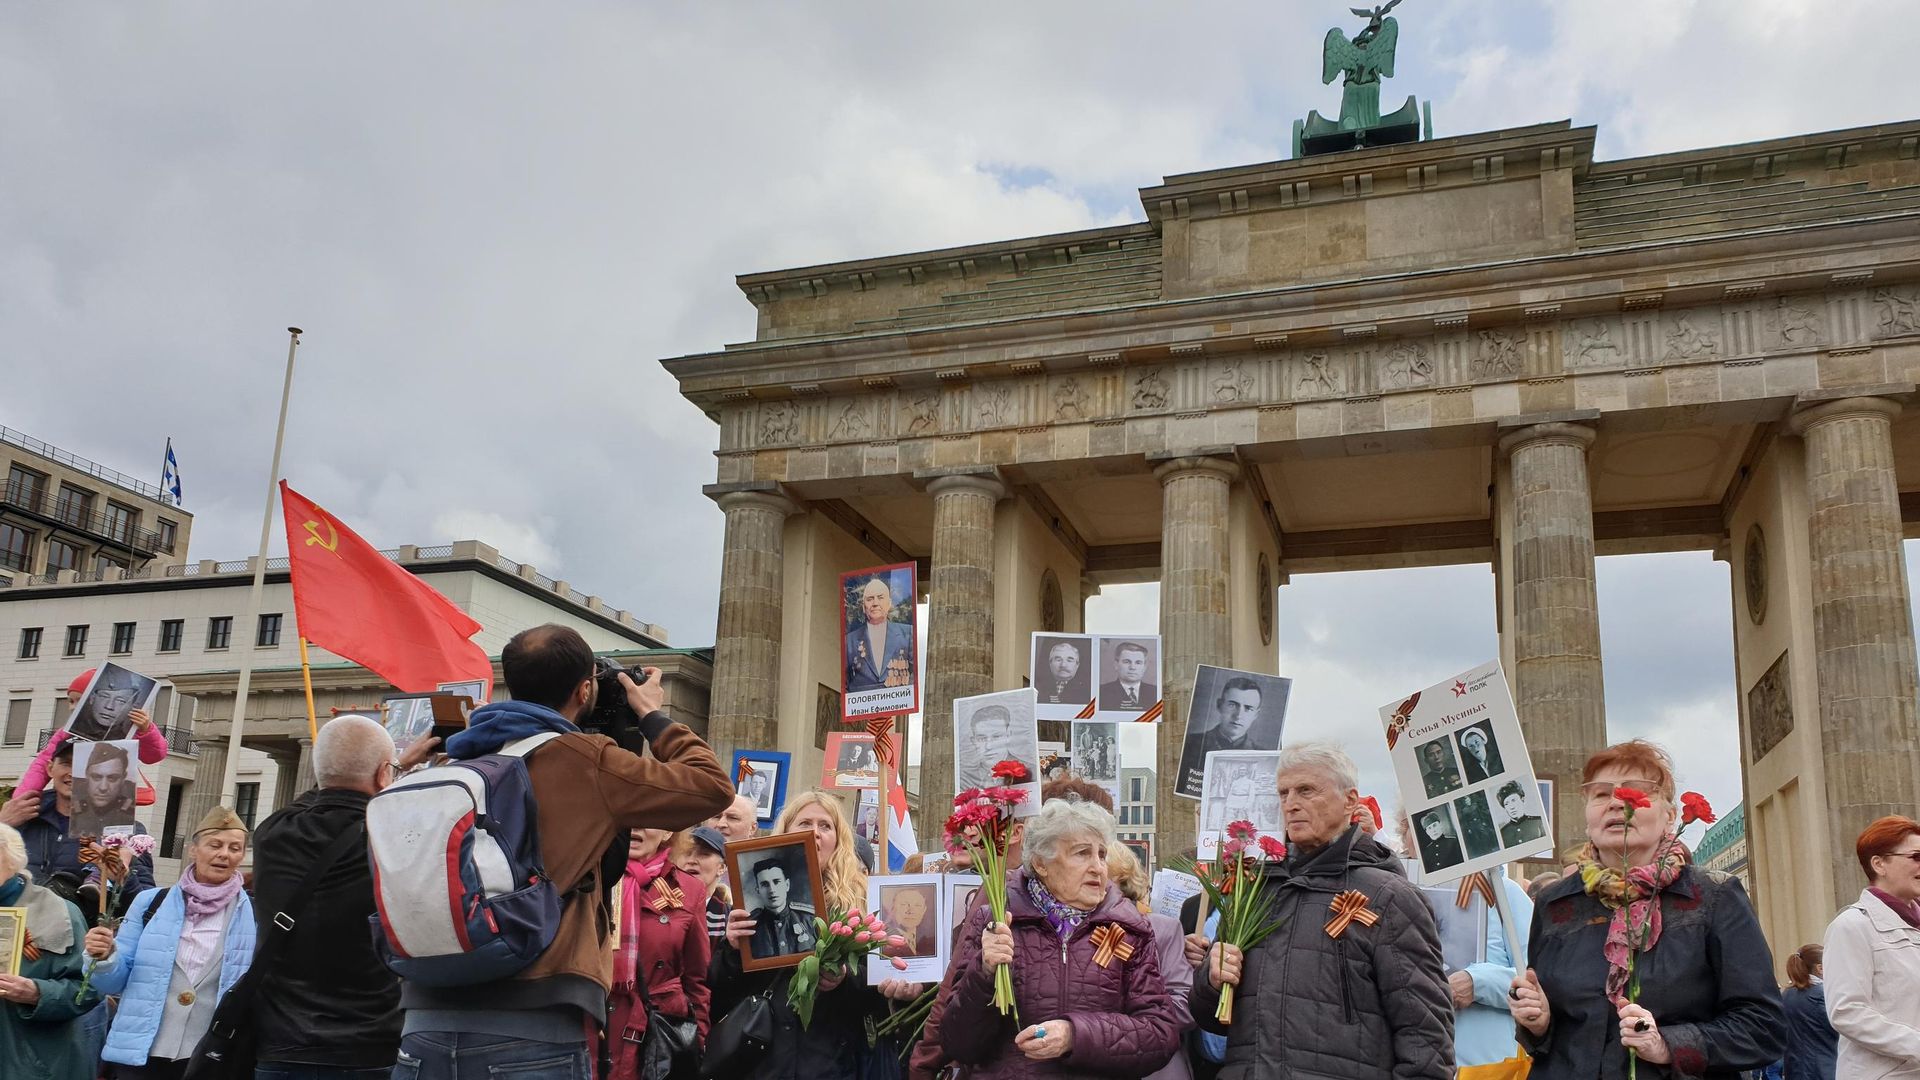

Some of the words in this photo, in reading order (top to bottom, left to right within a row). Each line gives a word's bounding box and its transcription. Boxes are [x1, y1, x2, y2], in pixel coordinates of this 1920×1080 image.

[847, 689, 911, 705] ГОЛОВЯТИНСКИЙ
[870, 703, 908, 714] Ефимович
[1408, 722, 1439, 739] Семья
[1441, 702, 1487, 725] Мусиных
